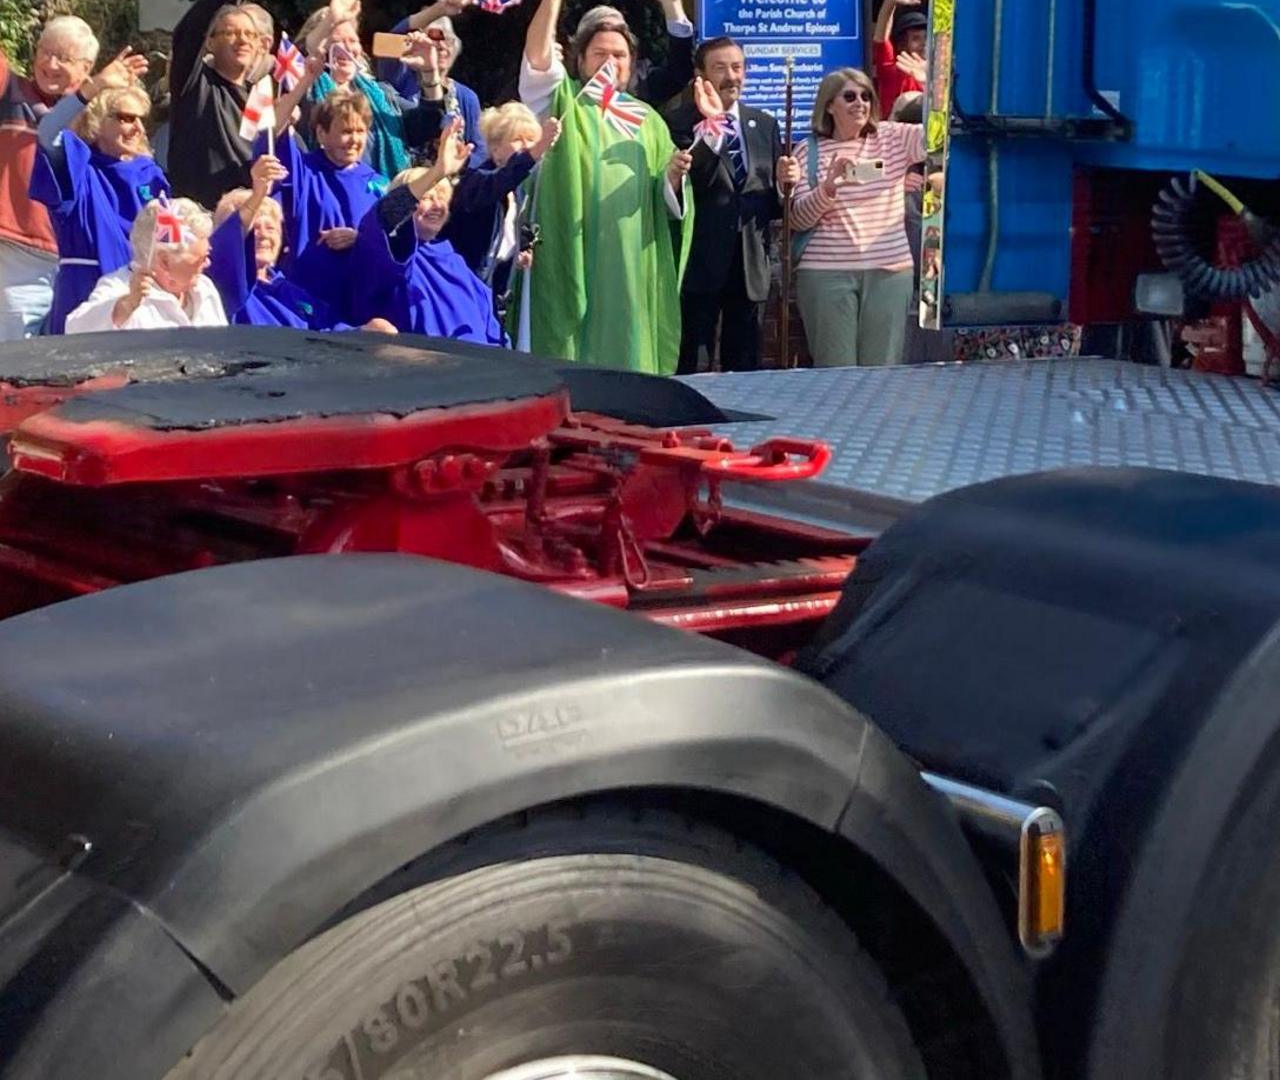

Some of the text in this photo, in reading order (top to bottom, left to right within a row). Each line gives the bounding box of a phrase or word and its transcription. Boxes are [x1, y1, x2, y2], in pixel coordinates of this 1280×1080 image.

[738, 8, 827, 19] the Parish Church of
[723, 22, 840, 35] Thorpe St Andrew Episcopi
[745, 46, 819, 54] SUNDAY SERVICES
